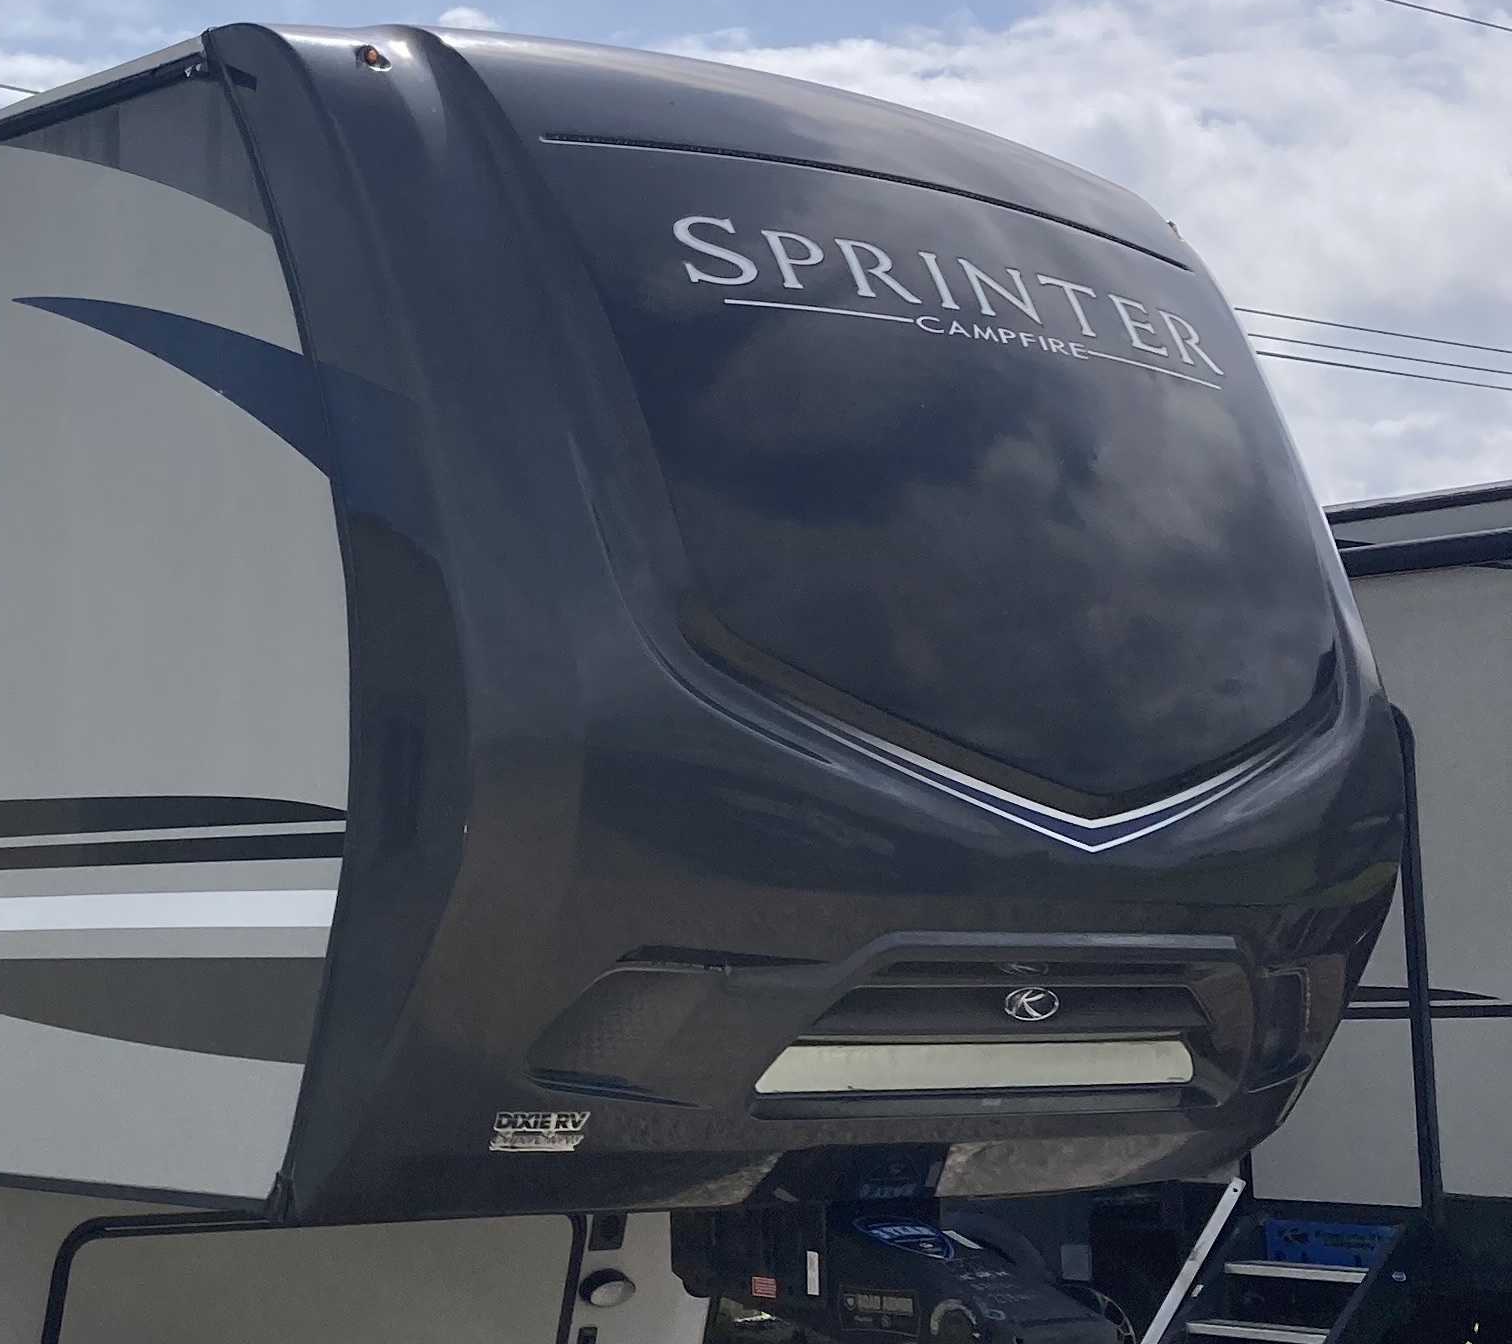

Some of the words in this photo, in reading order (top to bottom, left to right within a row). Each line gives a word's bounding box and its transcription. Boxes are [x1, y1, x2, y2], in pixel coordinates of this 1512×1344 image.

[672, 216, 1225, 377] SPRINTER
[915, 315, 1090, 360] CAMPFIRE
[496, 1112, 552, 1129] DIXIE
[555, 1112, 588, 1129] RV
